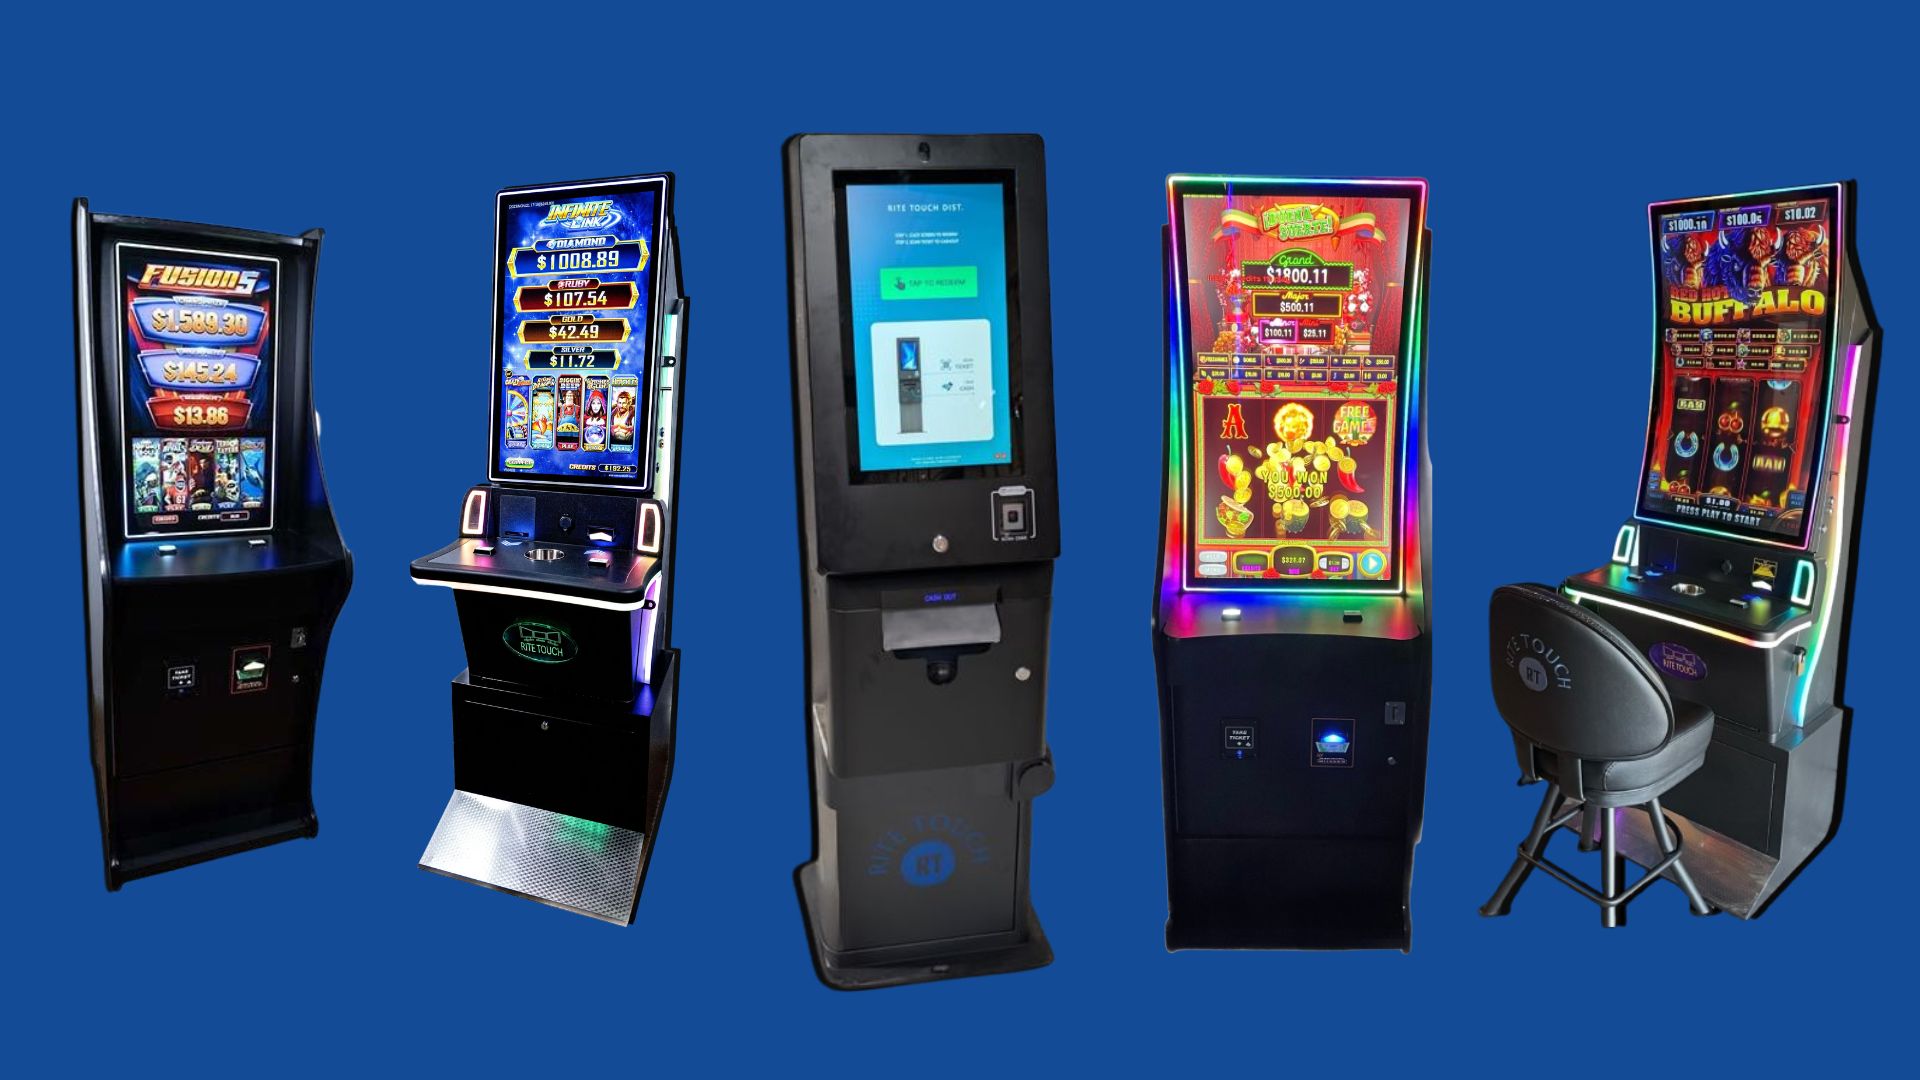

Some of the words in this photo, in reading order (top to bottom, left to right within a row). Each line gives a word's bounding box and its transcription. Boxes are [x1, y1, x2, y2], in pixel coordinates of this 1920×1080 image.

[545, 201, 613, 221] INFINITE
[887, 203, 906, 212] RITE
[909, 203, 939, 212] TOUCH
[942, 203, 964, 212] DIST.
[570, 215, 602, 229] LINK
[556, 237, 607, 250] DIAMOND
[536, 250, 620, 271] $1008.89
[1278, 254, 1315, 267] Grand
[564, 279, 591, 289] RUBY
[543, 290, 608, 307] $107.54
[1281, 290, 1310, 303] Major
[1279, 301, 1315, 313] $500.11
[561, 315, 584, 323] GOLD
[548, 324, 600, 340] $42.49
[1264, 327, 1293, 338] $100.11
[1303, 328, 1327, 338] $25.11
[560, 346, 585, 354] SILVER
[549, 354, 595, 368] $11.72
[163, 360, 238, 384] $145.24
[173, 405, 229, 426] $13.86
[1339, 405, 1370, 418] FREE
[1219, 402, 1249, 440] A
[1332, 420, 1377, 434] GAMES
[568, 463, 597, 471] CREDITS
[1262, 471, 1289, 485] YOU
[1296, 470, 1328, 484] WON
[1268, 485, 1323, 499] $500.00
[1676, 504, 1700, 517] PRESS
[1701, 508, 1721, 520] PLAY
[1722, 511, 1733, 522] TO
[1734, 514, 1761, 527] START
[520, 641, 537, 653] RITE
[536, 644, 564, 657] TOUCH
[1520, 633, 1572, 689] TOUCH
[1662, 659, 1677, 671] RITE
[1676, 661, 1698, 677] TOUCH
[1526, 666, 1542, 685] RT
[915, 854, 943, 878] RT
